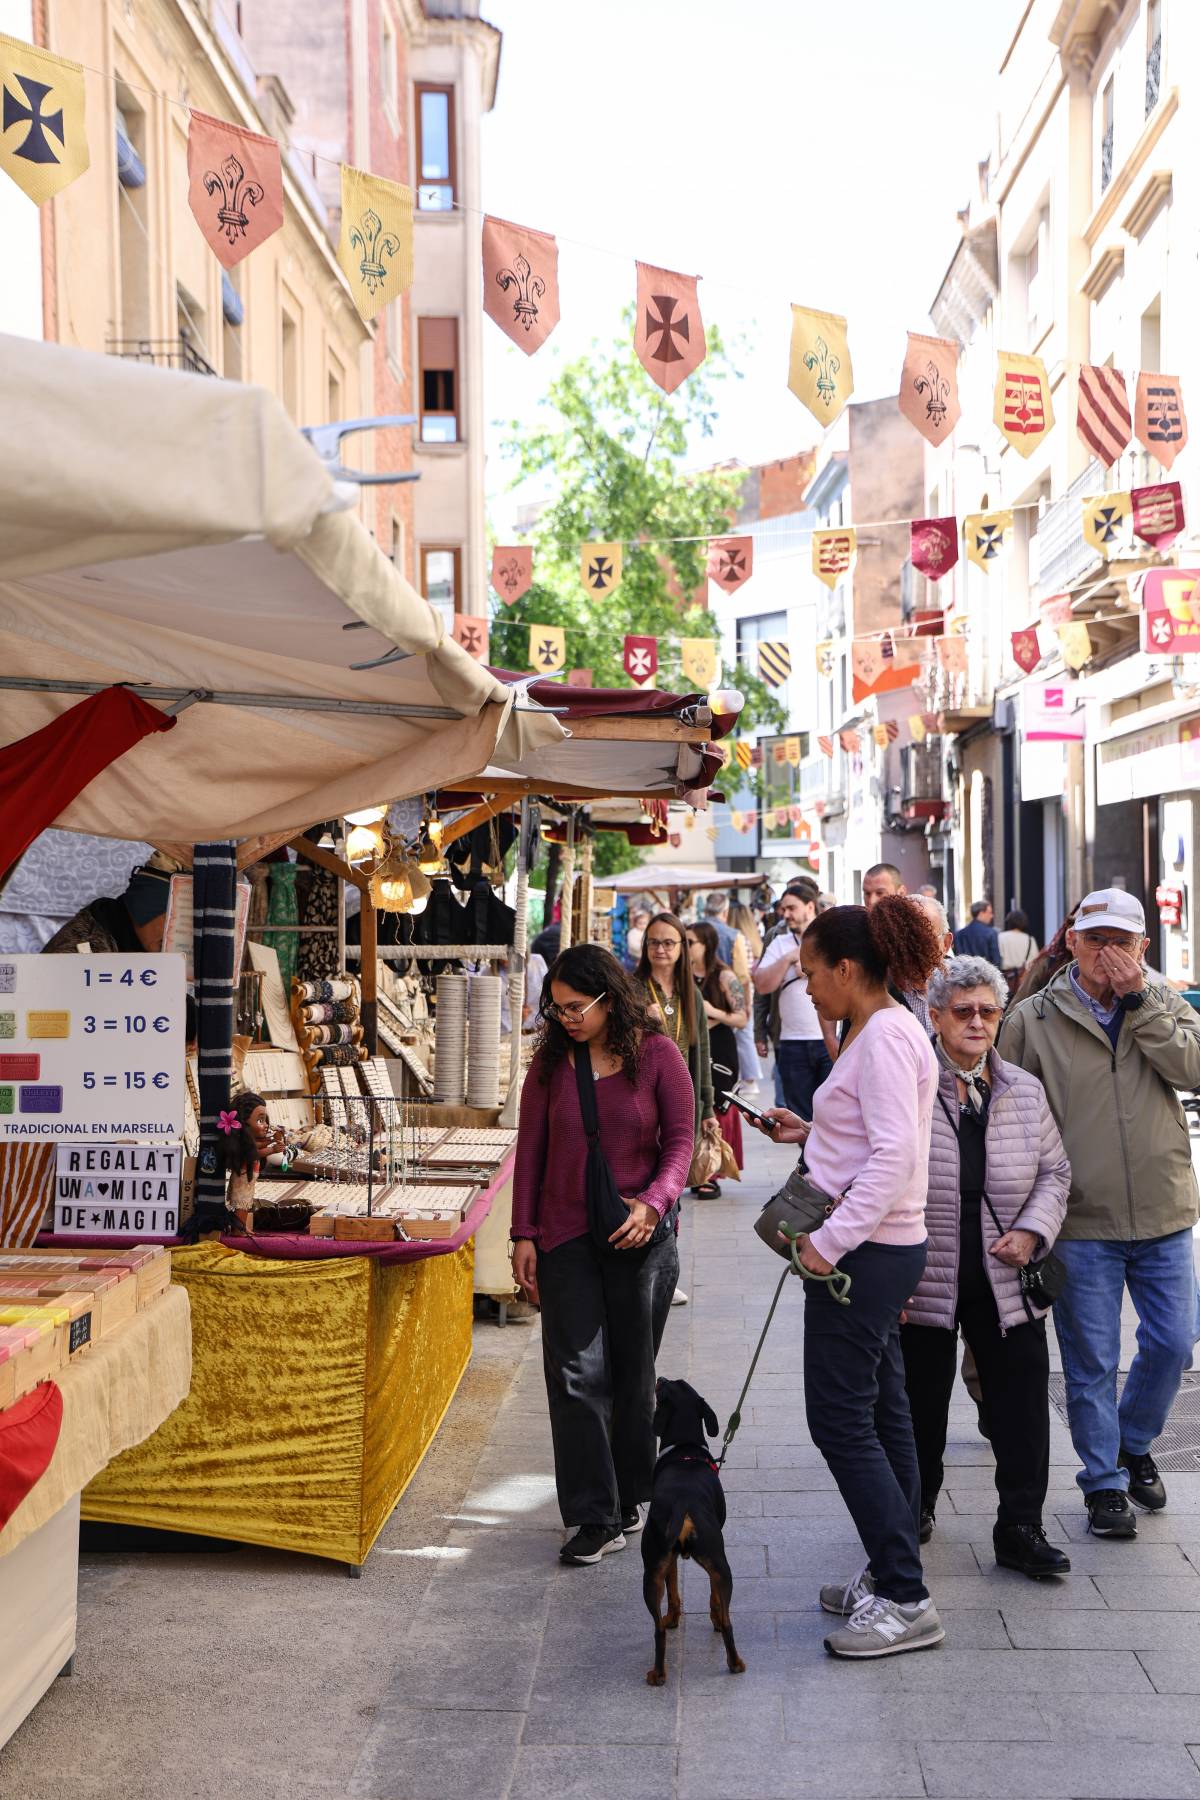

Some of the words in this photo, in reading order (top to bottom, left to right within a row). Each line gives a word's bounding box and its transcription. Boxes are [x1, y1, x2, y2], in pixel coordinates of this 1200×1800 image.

[124, 1015, 147, 1034] 10
[124, 1071, 146, 1090] 15
[4, 1123, 89, 1135] TRADICIONAL
[91, 1123, 108, 1135] EN
[110, 1123, 175, 1135] MARSELLA
[59, 1177, 95, 1200] UNA
[110, 1180, 169, 1201] MICA
[61, 1206, 87, 1229] DE
[103, 1209, 176, 1231] MAGIA
